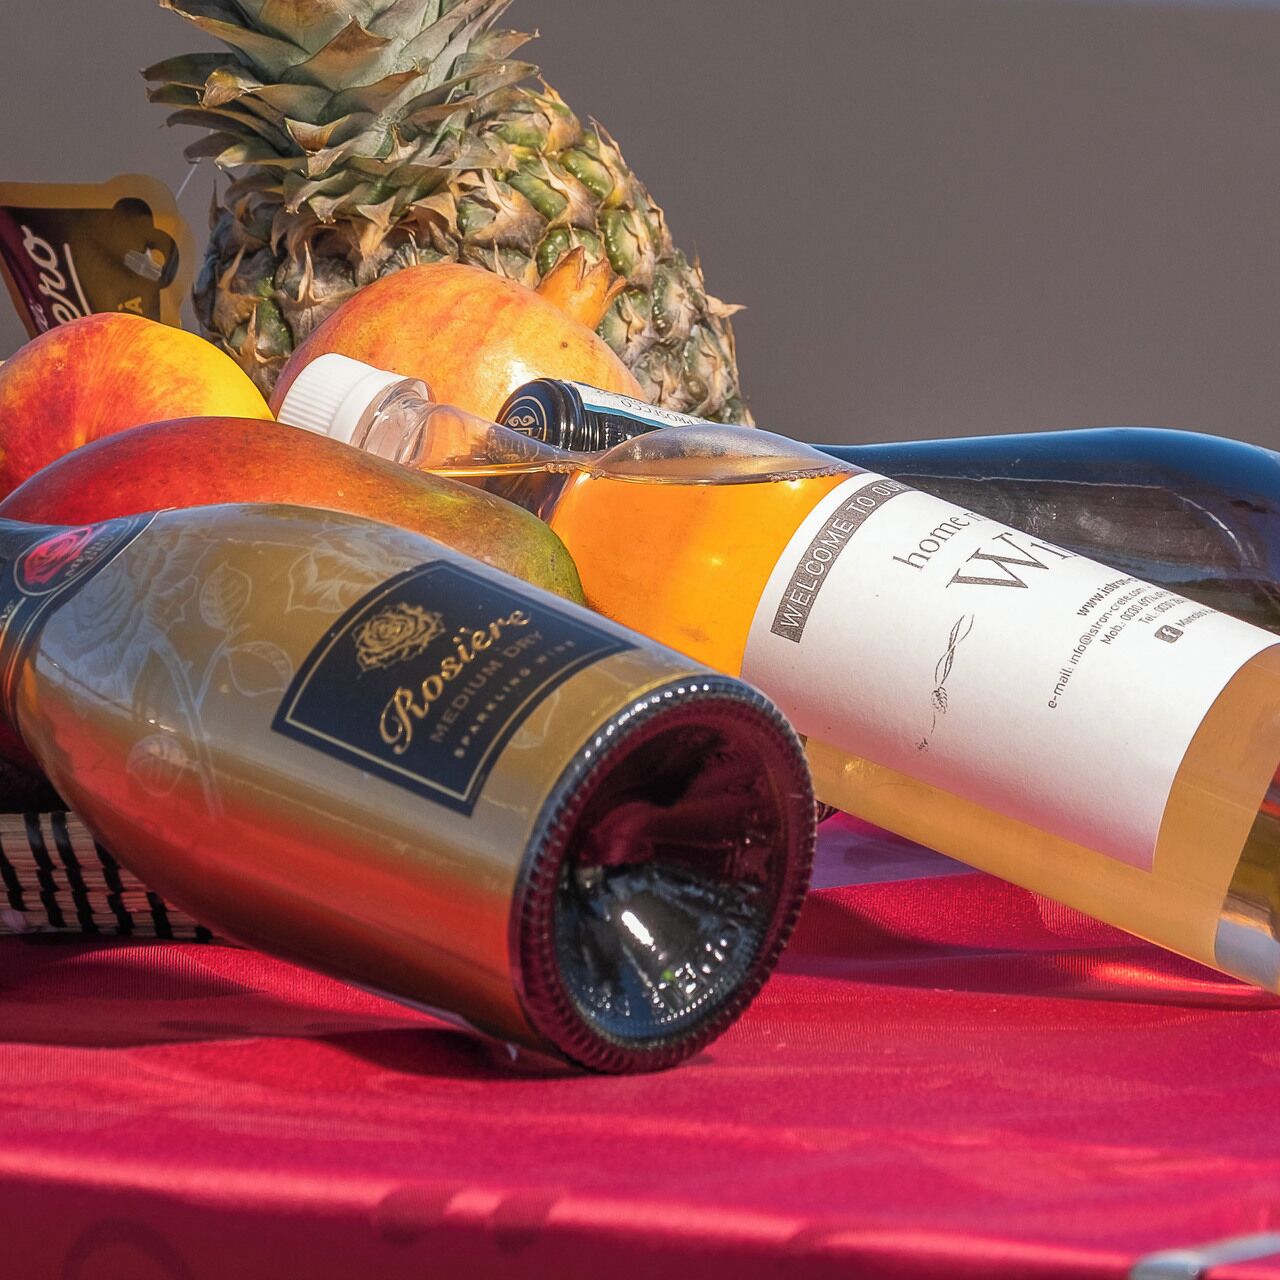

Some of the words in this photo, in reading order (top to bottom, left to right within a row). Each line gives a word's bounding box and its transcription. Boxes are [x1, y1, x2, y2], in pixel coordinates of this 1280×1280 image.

[780, 519, 854, 628] WELCOME
[845, 496, 876, 515] TO
[892, 515, 970, 571] home
[429, 660, 503, 743] MEDIUM
[503, 630, 544, 658] DRY
[453, 667, 531, 758] SPARKLING
